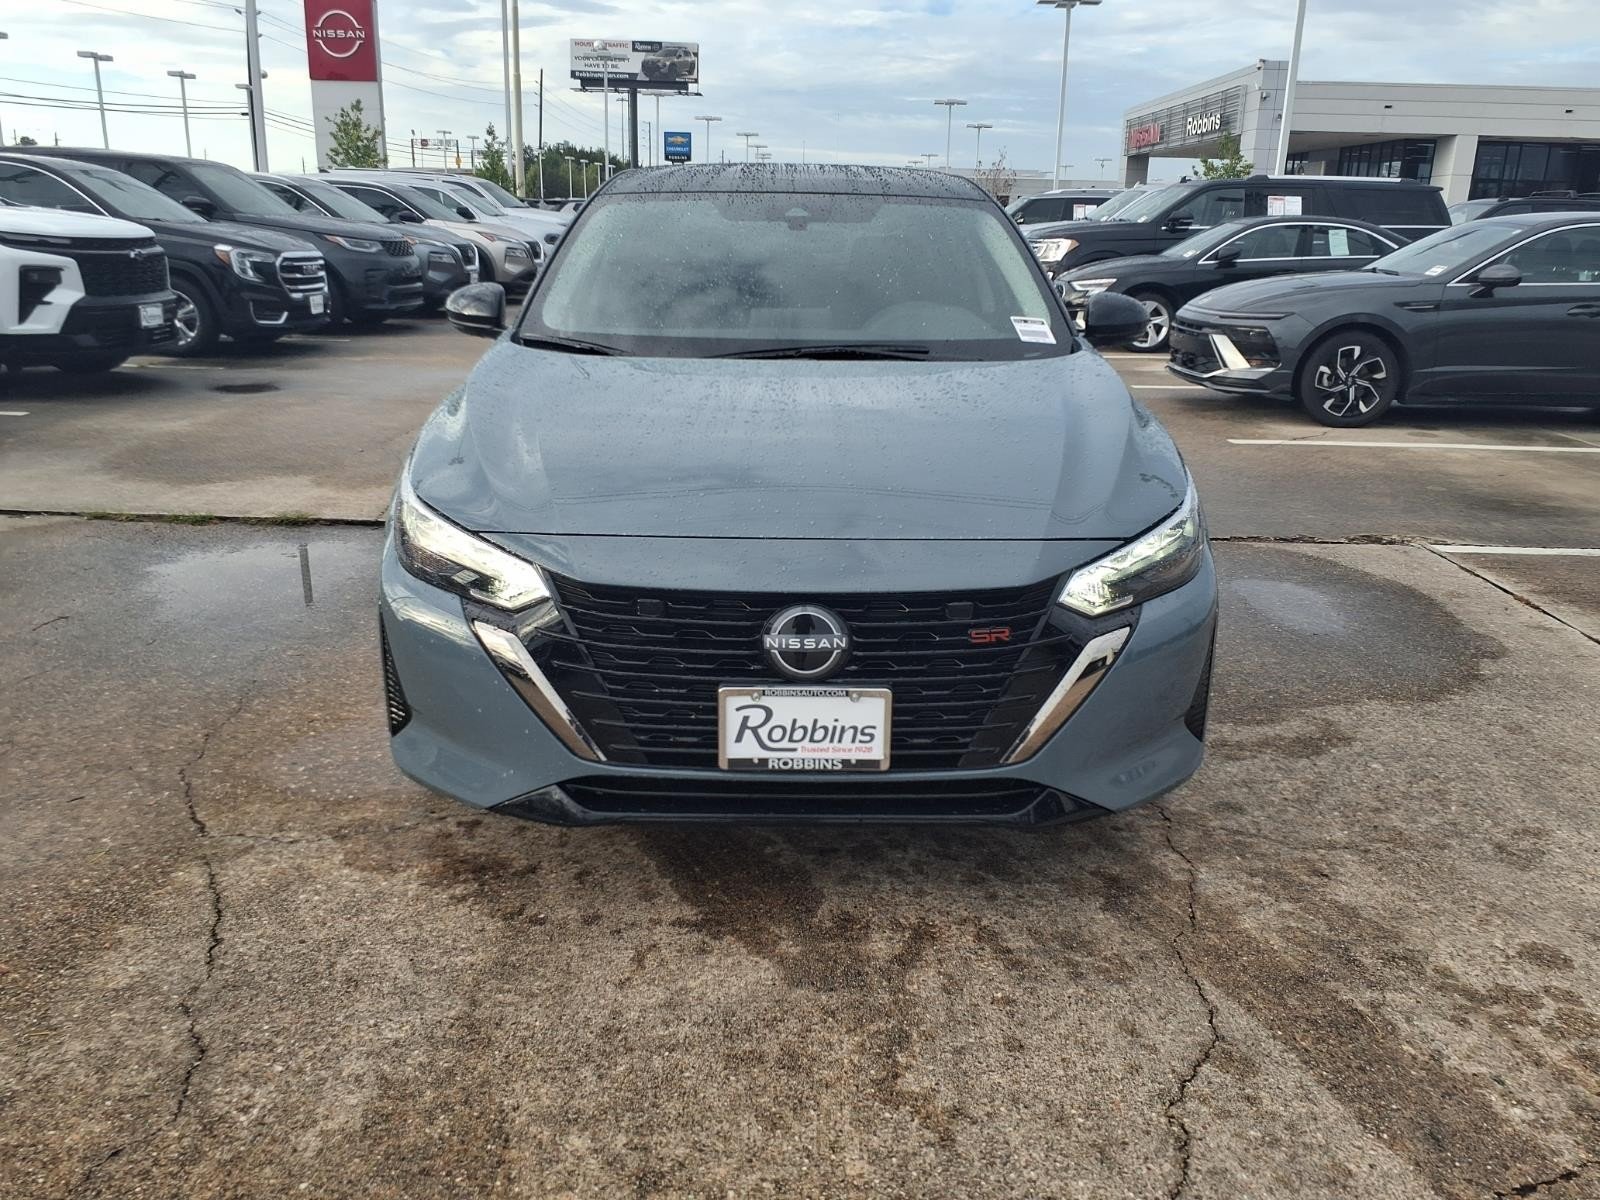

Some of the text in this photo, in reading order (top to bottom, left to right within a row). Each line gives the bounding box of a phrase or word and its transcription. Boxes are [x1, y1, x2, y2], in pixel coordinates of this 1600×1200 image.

[312, 29, 365, 38] NISSAN
[575, 71, 629, 79] RobbinsNian.com
[1186, 113, 1221, 136] Robbins
[1128, 123, 1161, 149] NISSAN
[968, 627, 1010, 643] SR
[766, 635, 847, 649] NISSAN
[764, 689, 847, 697] ROBBINSAUTO.COM
[734, 704, 877, 752] Robbins
[800, 745, 830, 753] Trusted
[831, 745, 853, 753] Since
[768, 757, 843, 770] ROBBINS
